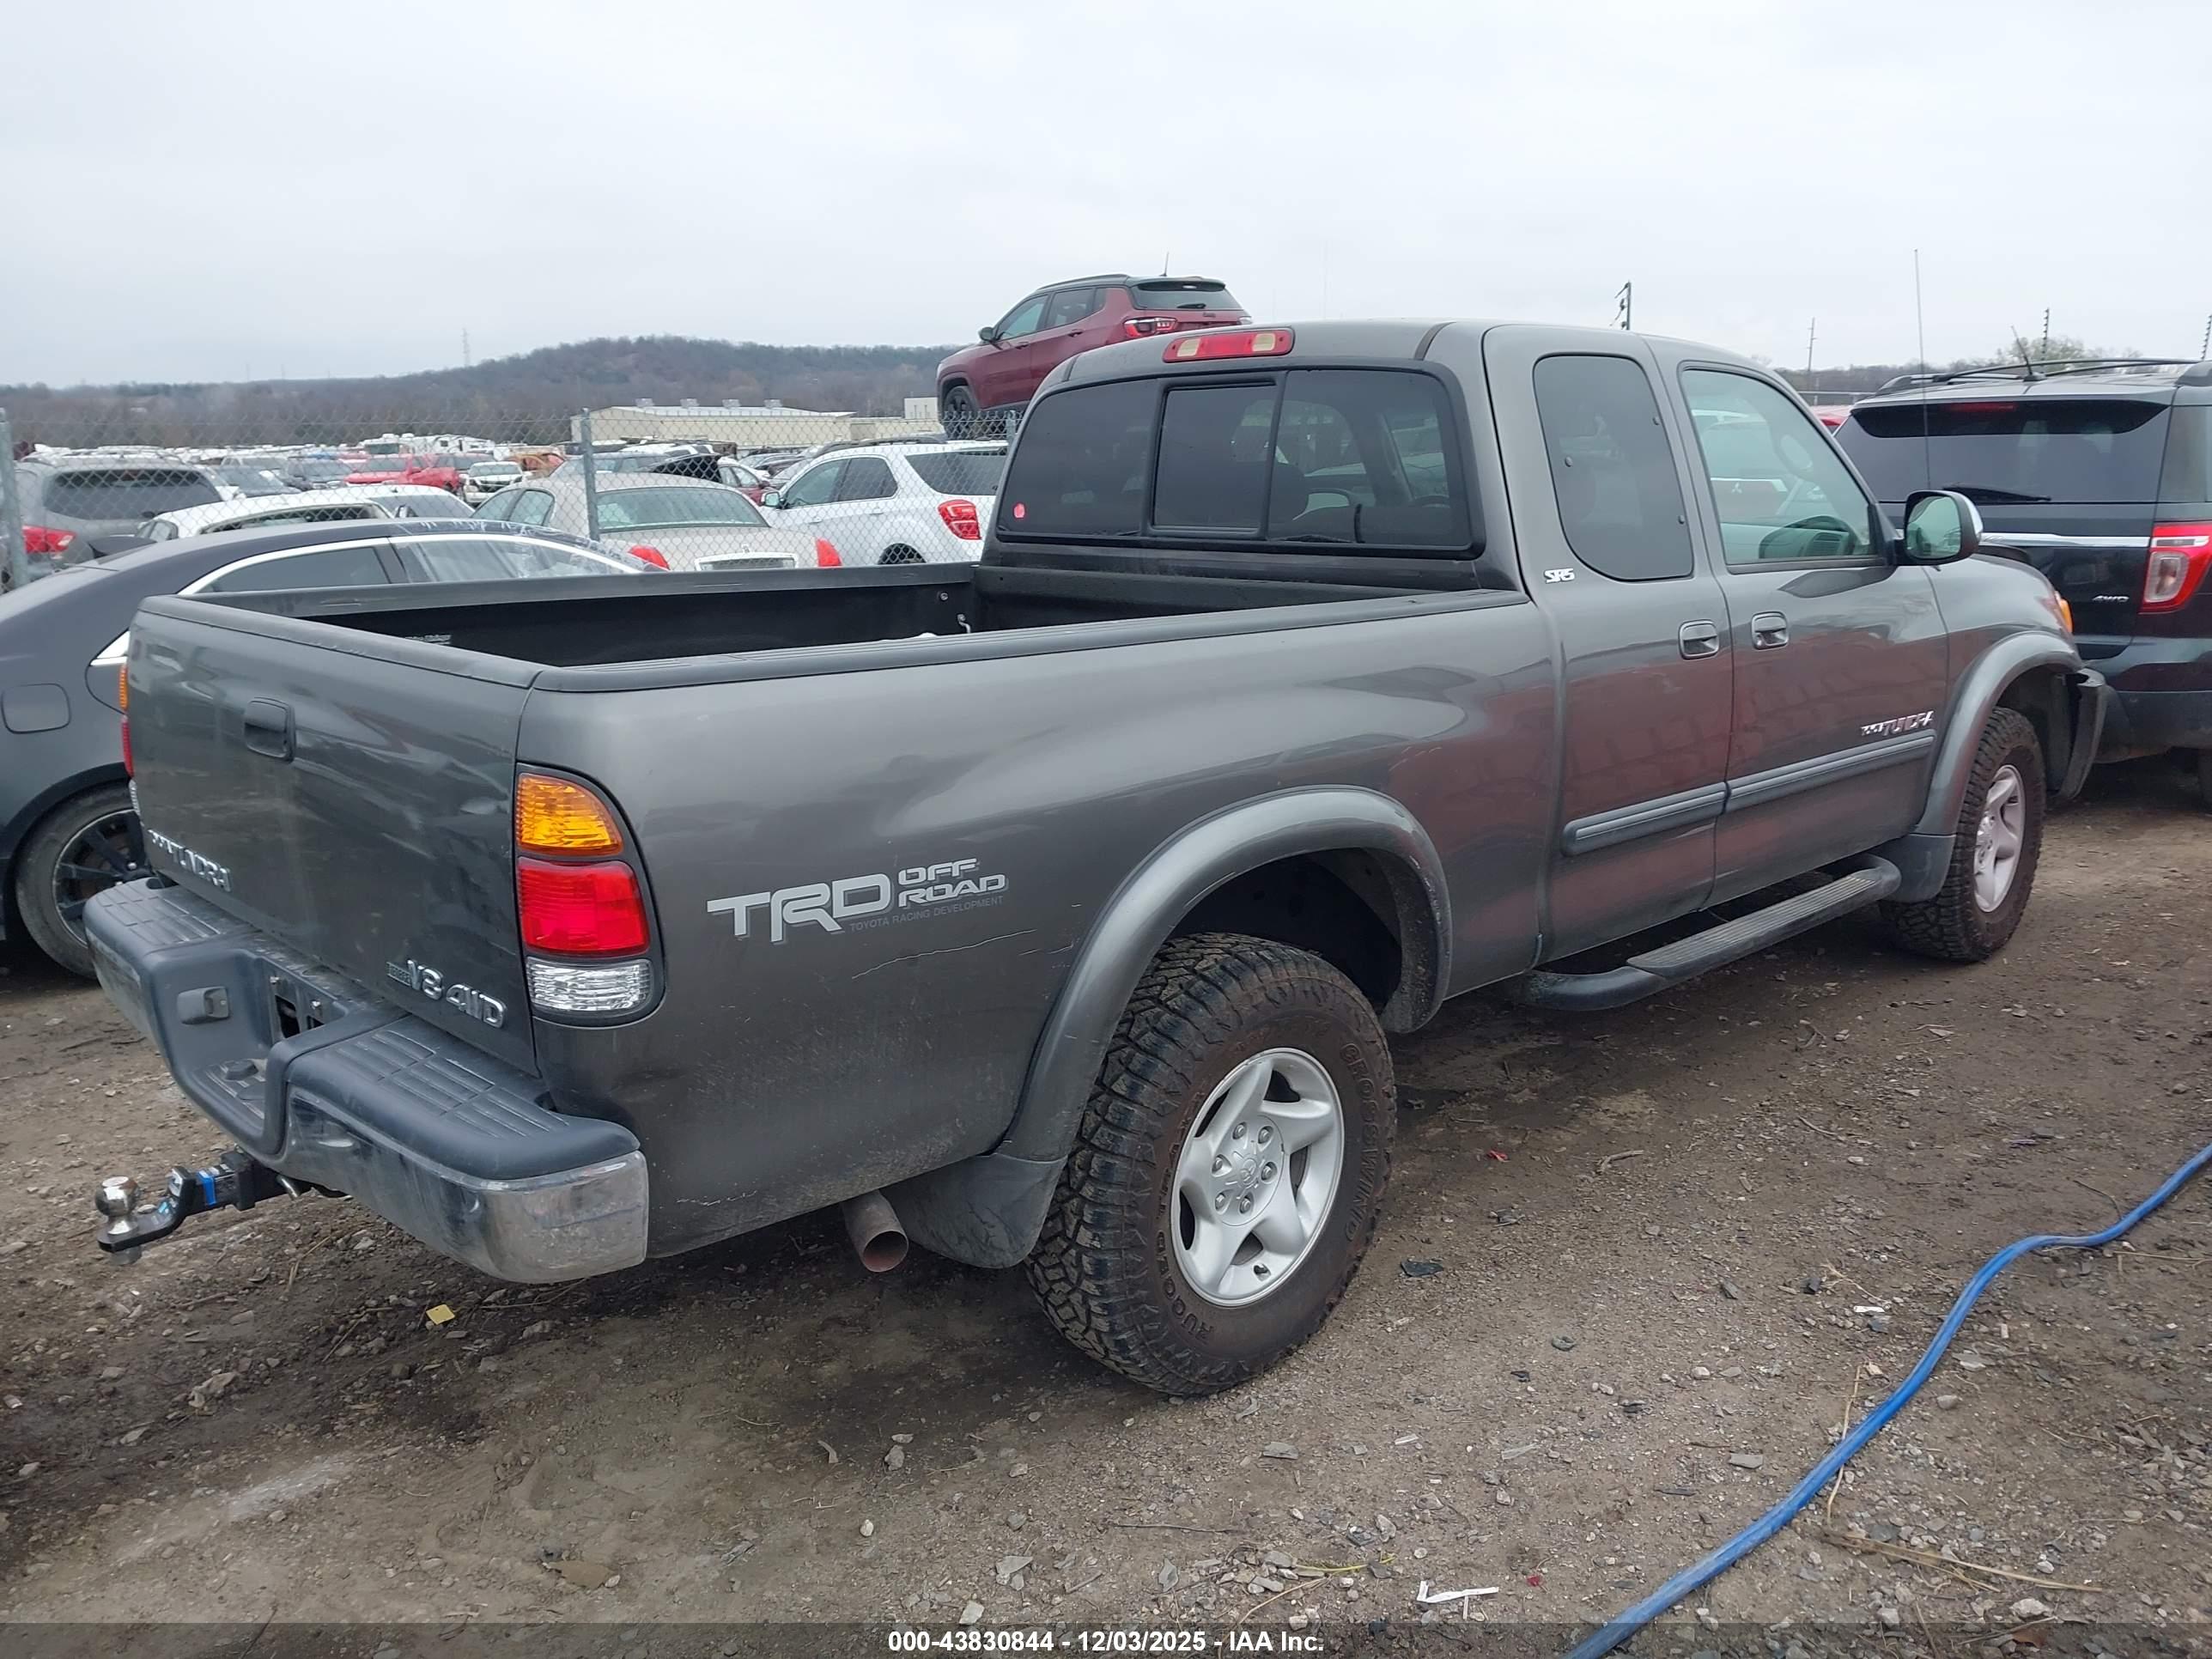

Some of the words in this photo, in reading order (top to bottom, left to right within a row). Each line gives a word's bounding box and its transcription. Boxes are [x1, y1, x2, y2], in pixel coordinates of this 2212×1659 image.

[1544, 568, 1575, 583] SR5
[2092, 595, 2130, 604] 4WD
[898, 857, 980, 885] OFF
[707, 873, 892, 944] TRD
[898, 873, 1009, 908] ROAD
[849, 916, 890, 933] TOYOTA
[892, 908, 931, 925] RACING
[933, 895, 1004, 916] DEVELOPMENT
[407, 959, 444, 1001] V8
[447, 983, 508, 1030] 4WD
[1340, 1043, 1380, 1243] CROSSWIND
